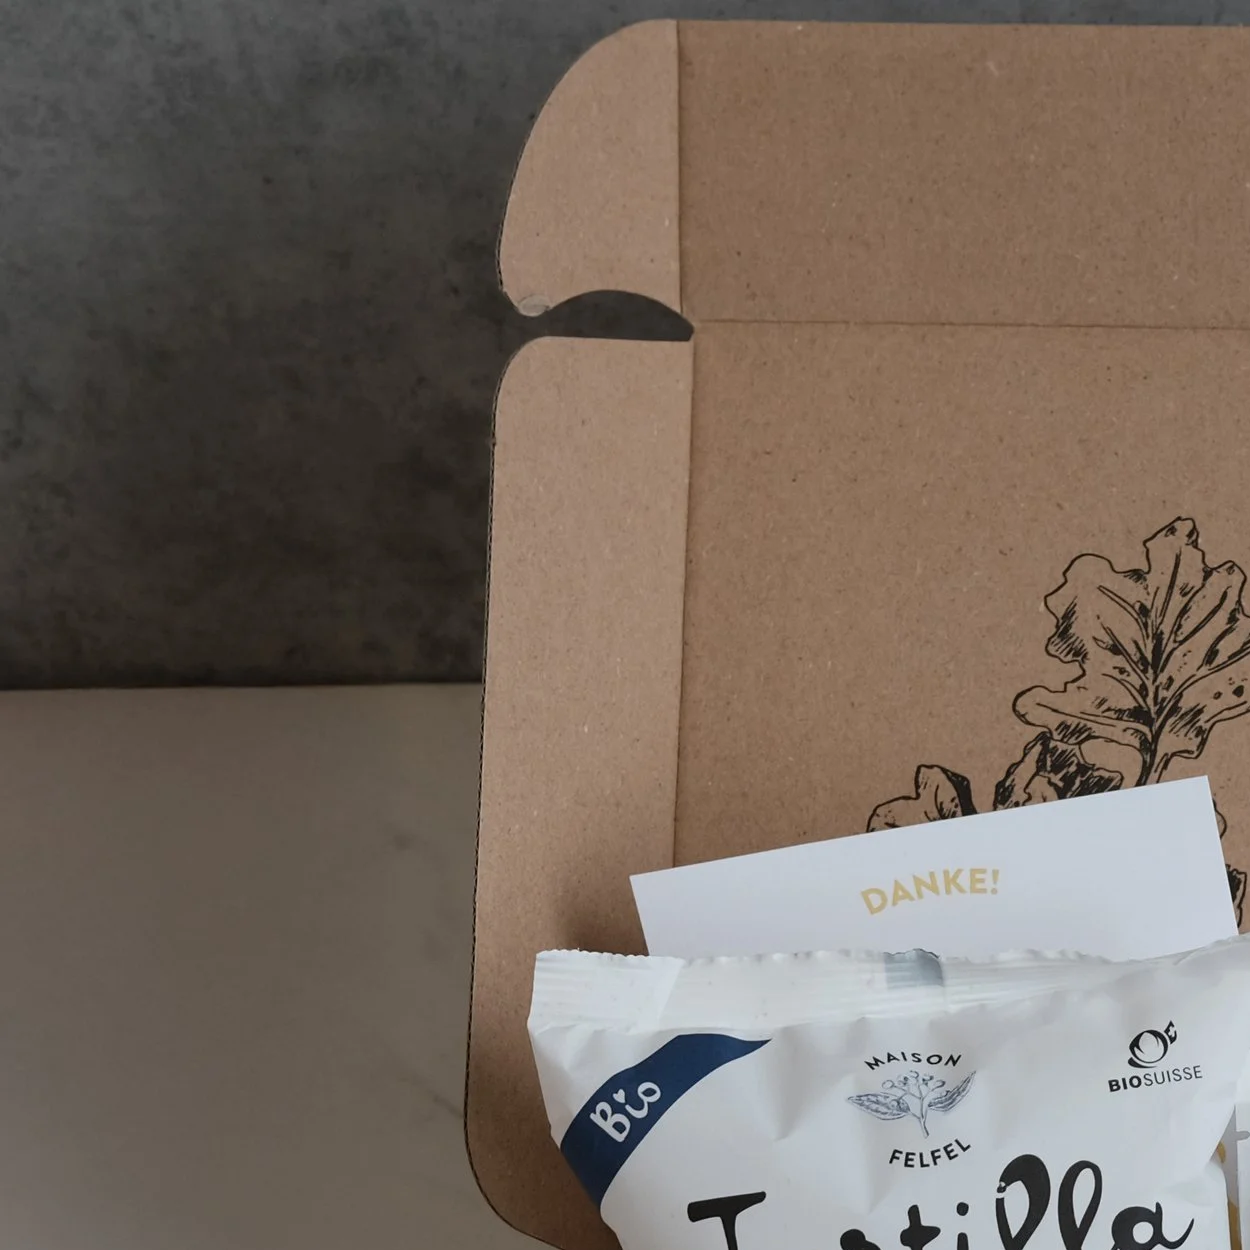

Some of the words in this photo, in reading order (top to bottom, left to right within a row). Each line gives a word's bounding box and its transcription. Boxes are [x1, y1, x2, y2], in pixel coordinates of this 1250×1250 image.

[860, 867, 1000, 915] DANKE!
[864, 1051, 961, 1070] MAISON
[590, 1082, 661, 1142] Bio
[889, 1138, 971, 1167] FELFEL
